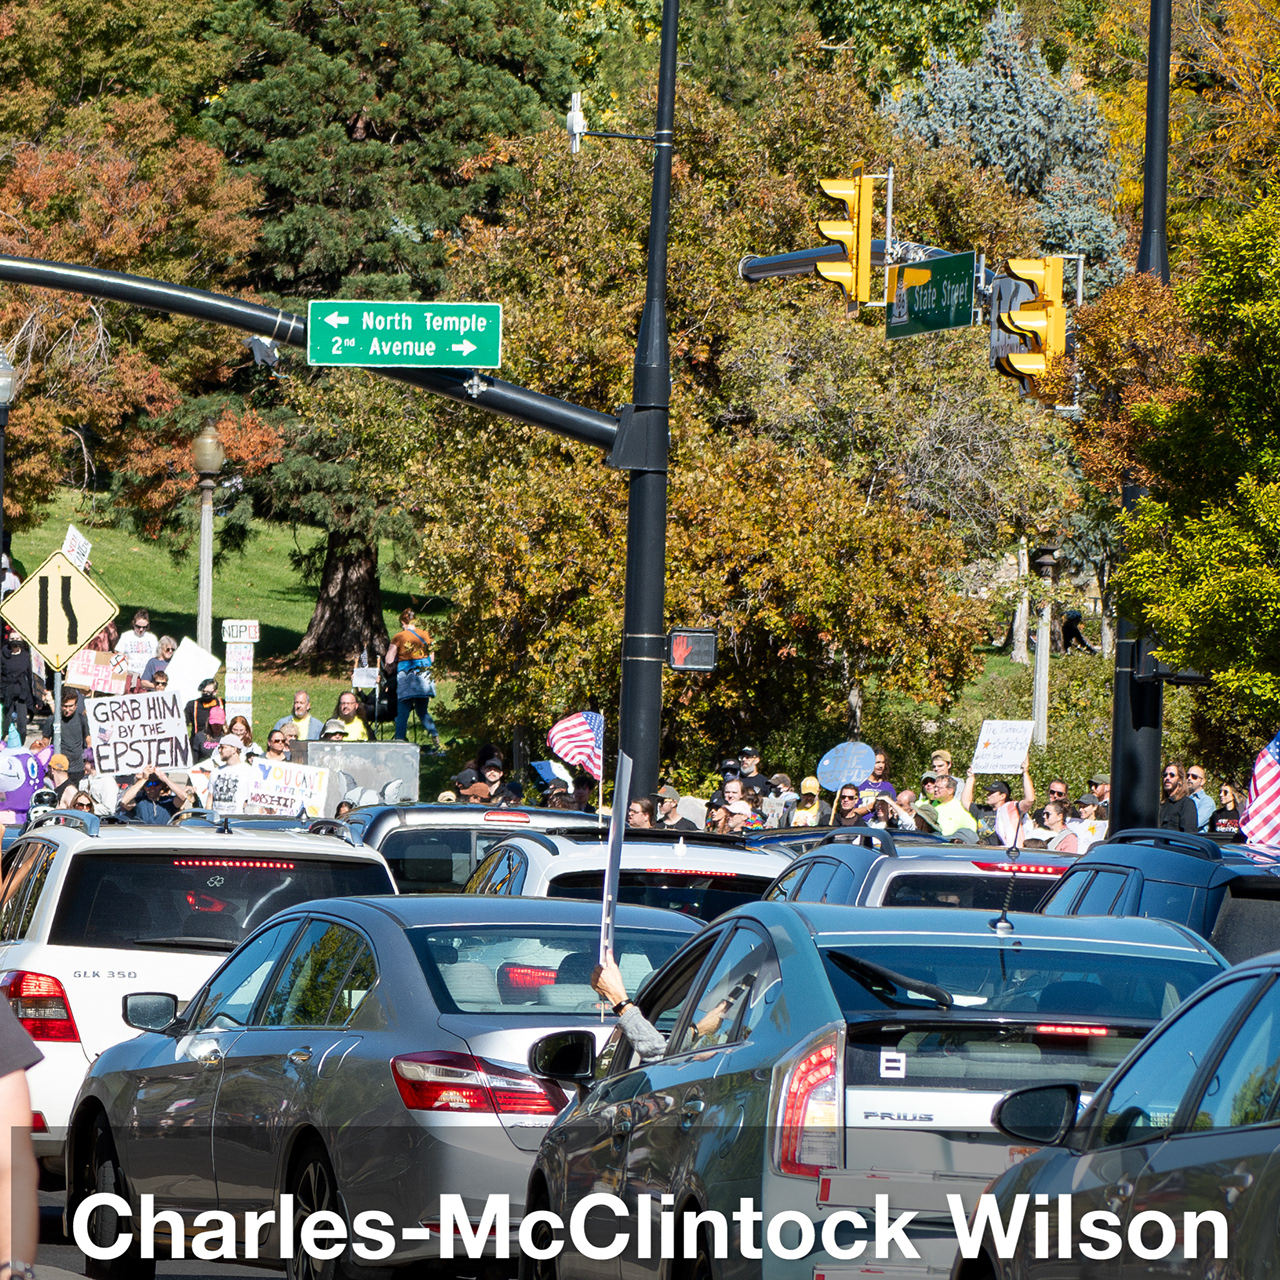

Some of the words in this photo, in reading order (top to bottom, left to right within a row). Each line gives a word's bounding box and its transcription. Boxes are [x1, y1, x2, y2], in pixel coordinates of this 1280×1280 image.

[914, 285, 937, 312] State
[942, 278, 969, 307] Street
[362, 311, 412, 330] North
[424, 312, 487, 335] Temple
[332, 336, 355, 355] 2nd
[369, 337, 436, 357] Avenue
[93, 699, 142, 723] GRAB
[146, 694, 181, 721] HIM
[118, 724, 135, 738] BY
[140, 722, 166, 736] THE
[986, 723, 997, 735] The
[96, 734, 189, 774] EPSTEIN
[834, 742, 868, 755] WE
[833, 754, 864, 769] THE
[258, 763, 292, 785] YOU
[295, 771, 326, 792] CAN'T
[819, 769, 871, 783] PEOPLE
[107, 971, 137, 979] 350
[863, 1111, 934, 1122] PRIUS
